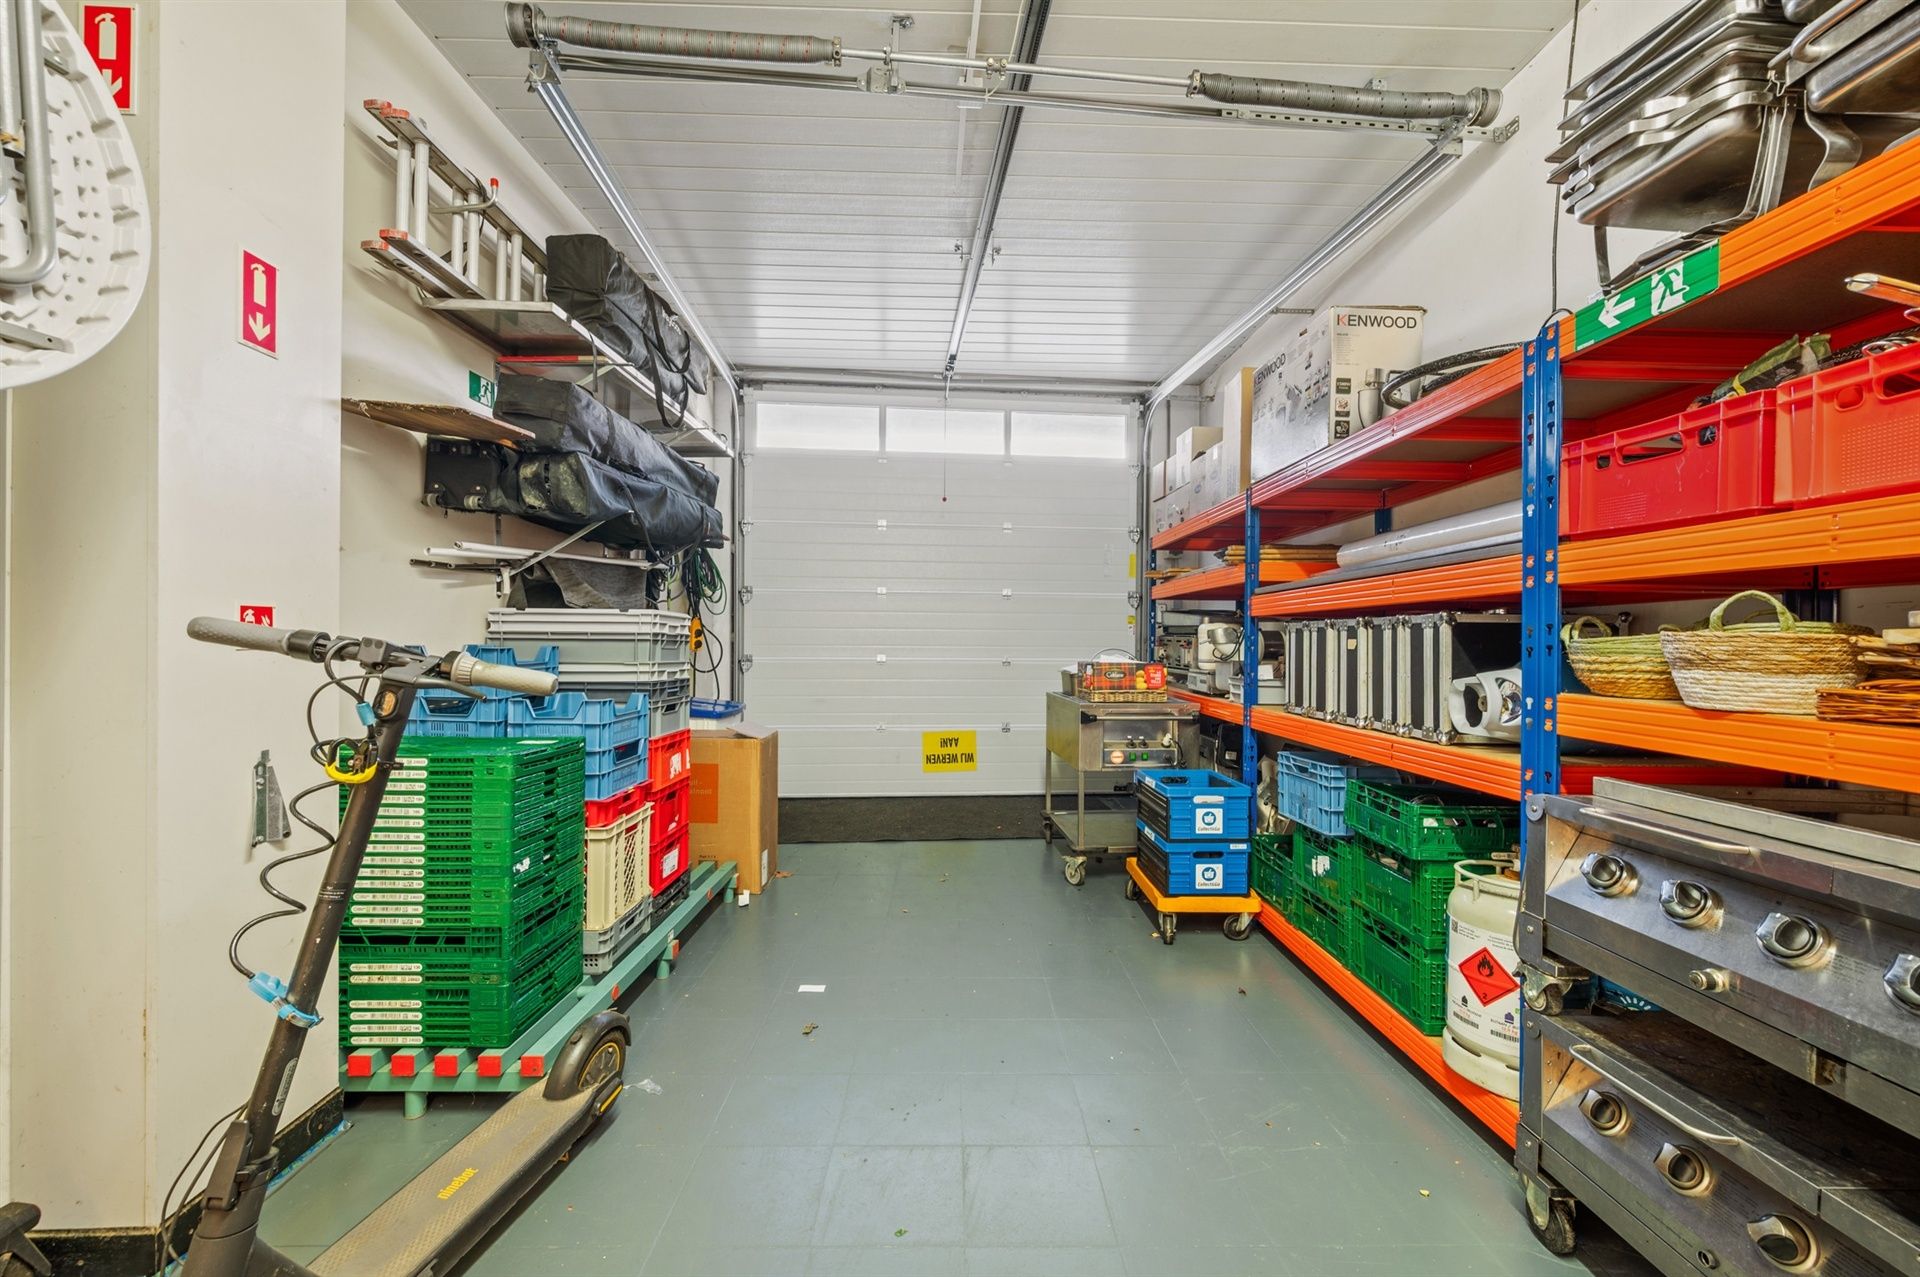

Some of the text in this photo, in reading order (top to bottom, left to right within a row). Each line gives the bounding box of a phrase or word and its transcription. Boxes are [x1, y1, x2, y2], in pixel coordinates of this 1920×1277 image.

[1337, 313, 1417, 329] KENWOOD
[940, 737, 959, 748] AAN!
[926, 752, 974, 764] WIJ WERVEN
[1482, 992, 1488, 1000] 2
[437, 1167, 479, 1200] ninebot
